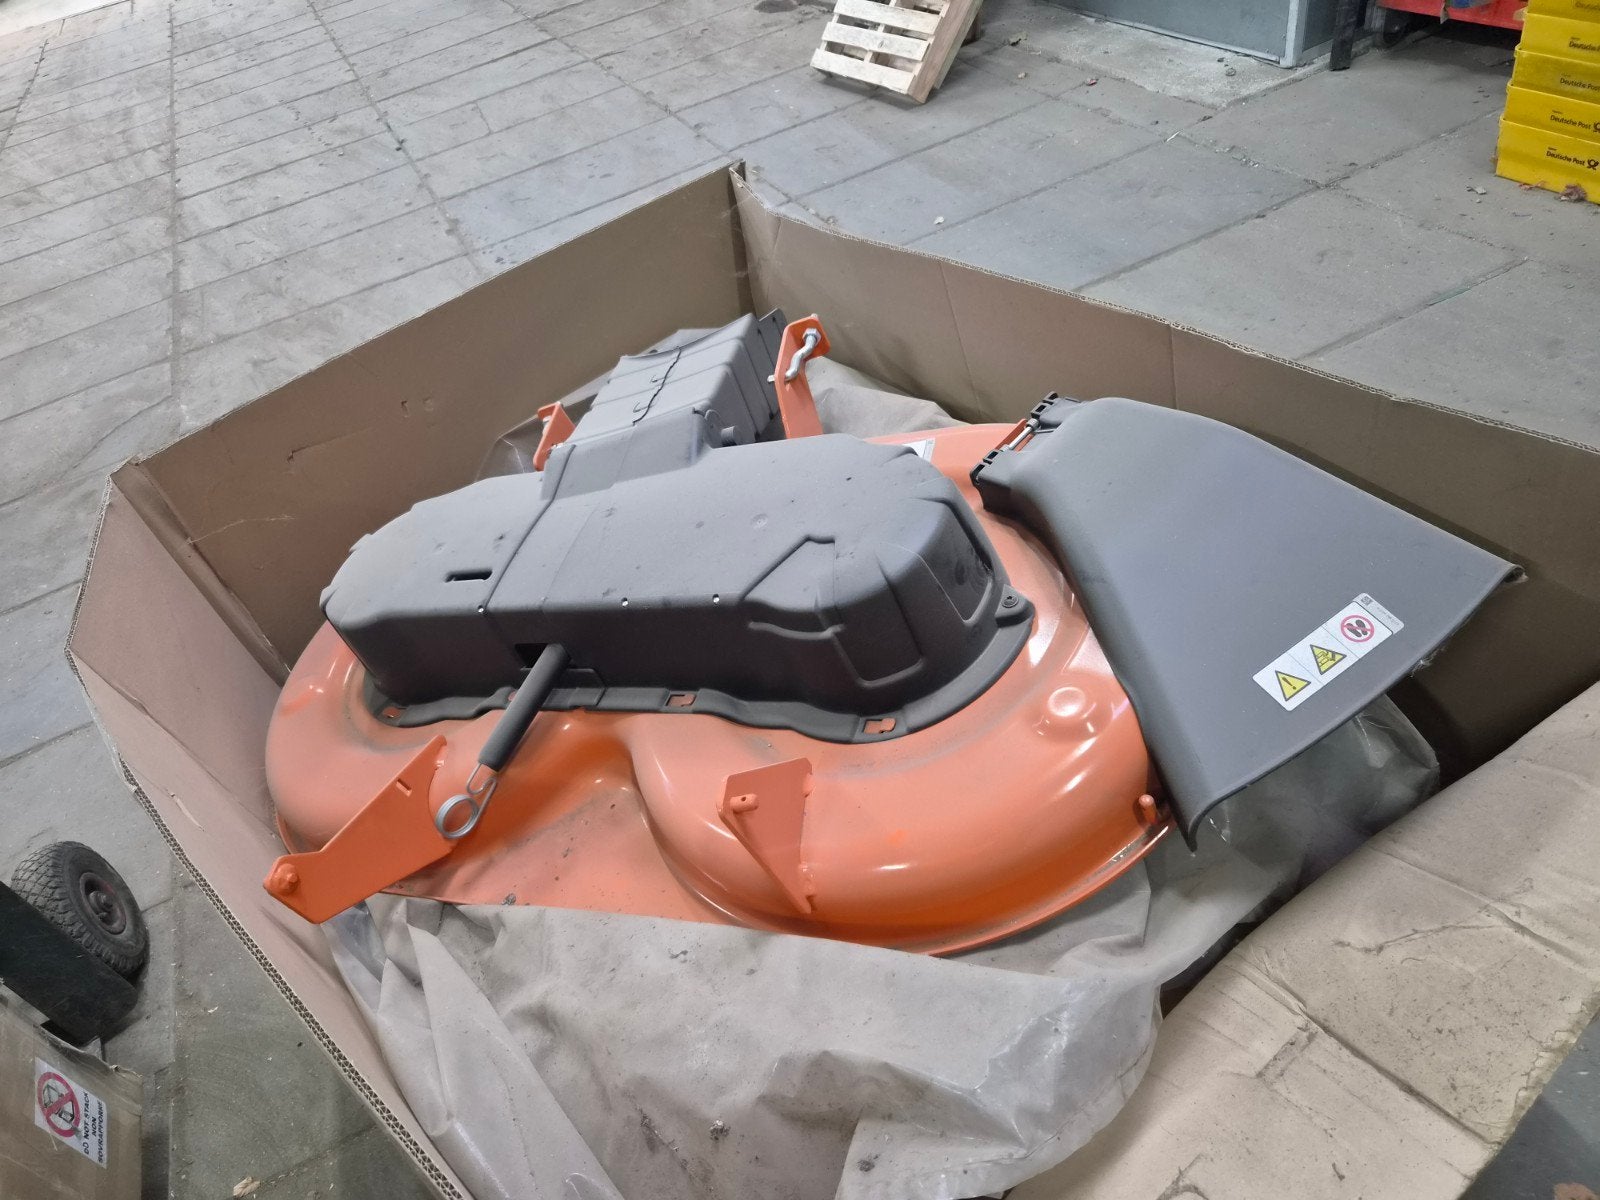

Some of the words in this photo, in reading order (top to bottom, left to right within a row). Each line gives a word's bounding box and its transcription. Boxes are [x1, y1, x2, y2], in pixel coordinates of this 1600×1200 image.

[1550, 114, 1577, 126] Deutsche
[1577, 121, 1592, 130] Post
[1546, 150, 1572, 162] Deutsche
[1572, 157, 1586, 166] Post
[83, 1141, 90, 1155] DO
